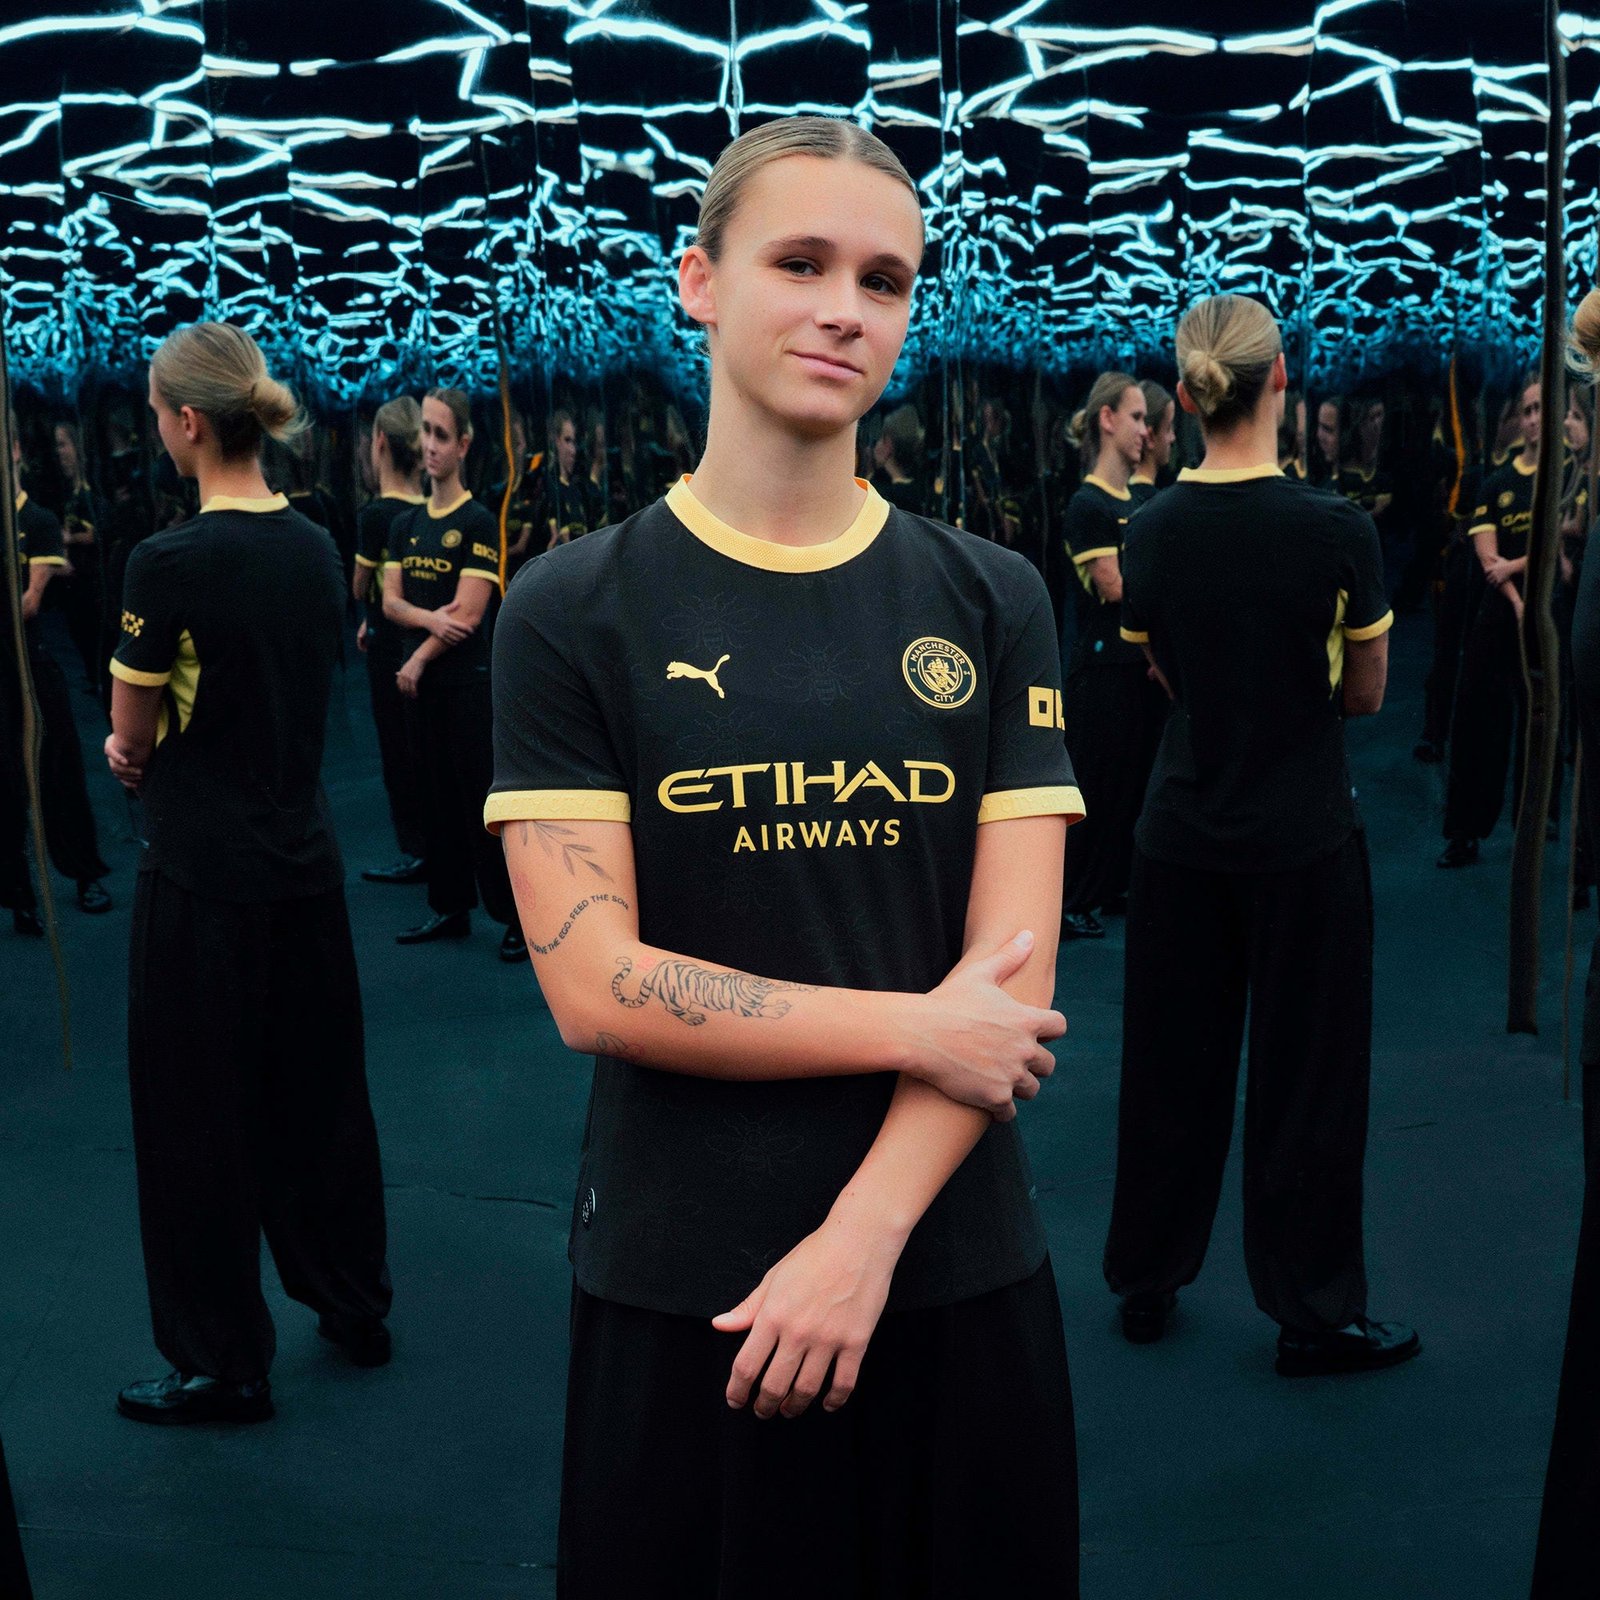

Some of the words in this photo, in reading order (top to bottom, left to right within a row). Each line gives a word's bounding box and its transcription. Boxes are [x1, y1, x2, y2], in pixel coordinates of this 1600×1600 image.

[910, 642, 966, 665] MANCHESTER
[934, 694, 955, 702] CITY
[657, 760, 956, 813] ETIHAD
[733, 819, 901, 853] AIRWAYS
[569, 899, 589, 920] FEED
[591, 894, 609, 903] THE
